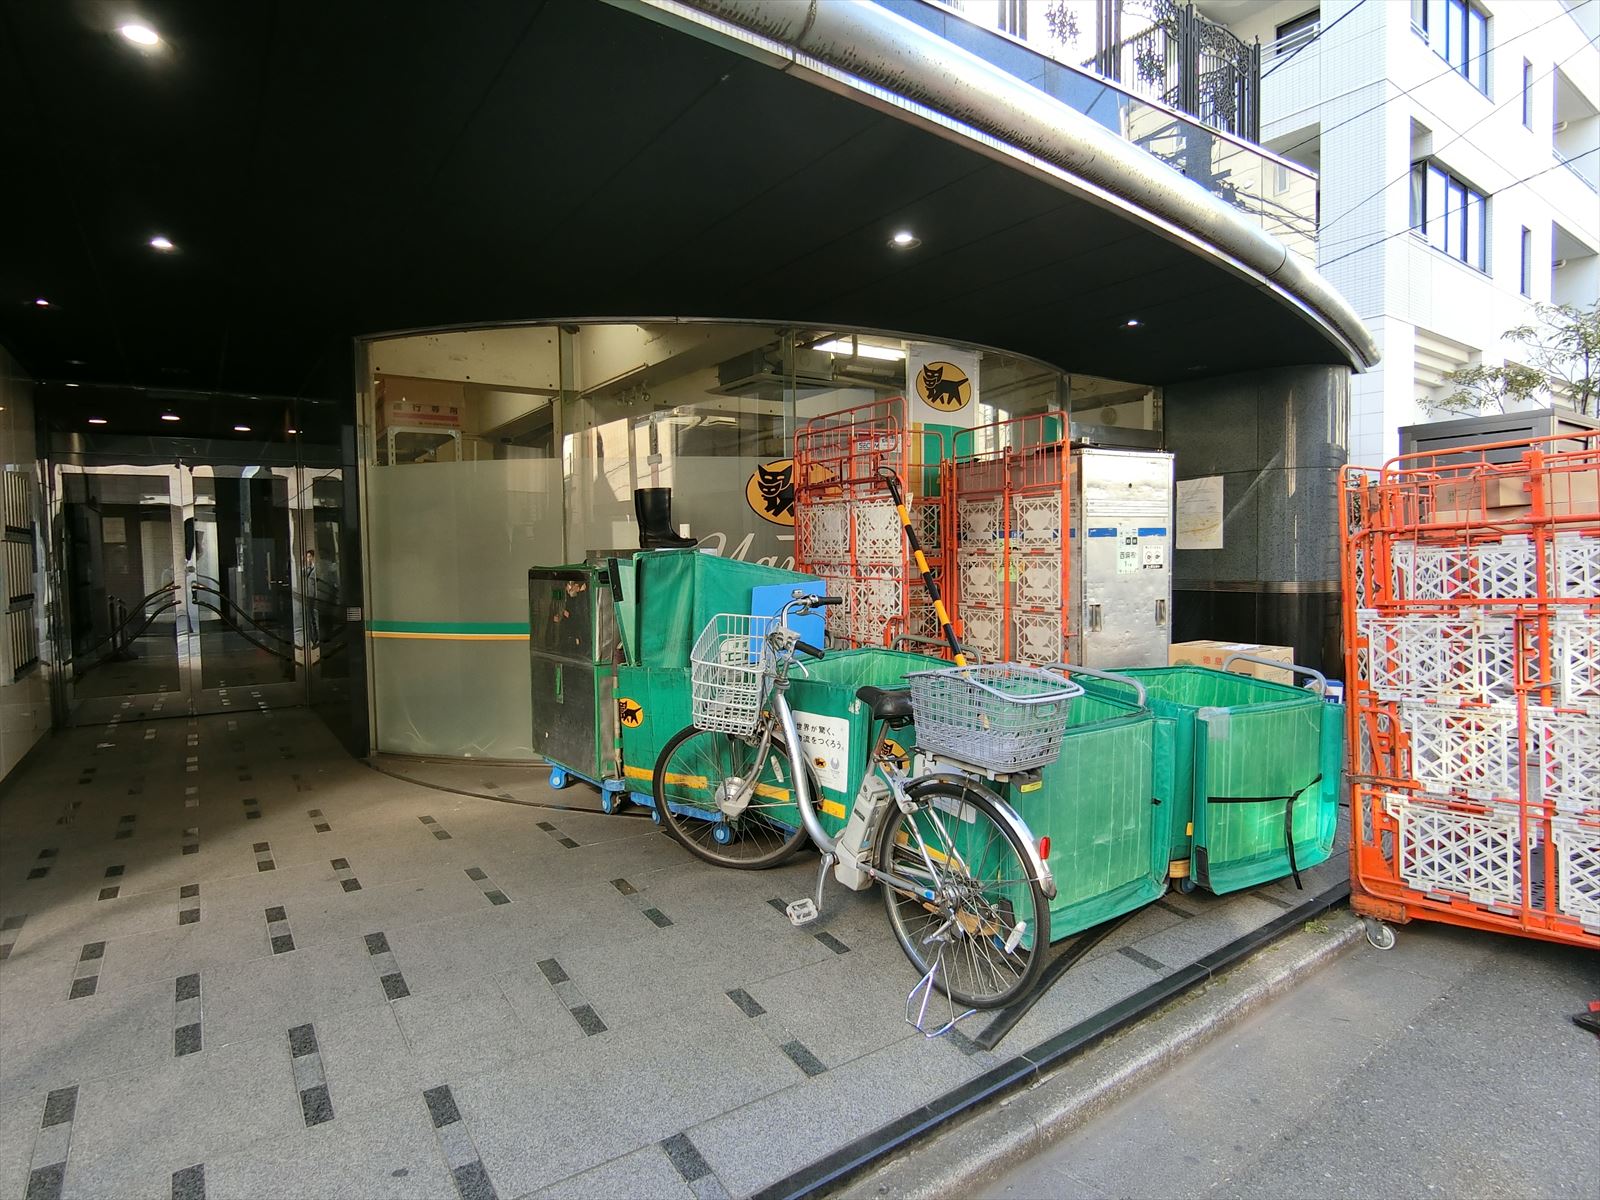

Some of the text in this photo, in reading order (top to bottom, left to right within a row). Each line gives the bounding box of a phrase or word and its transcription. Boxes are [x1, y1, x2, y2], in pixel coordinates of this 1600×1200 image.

[796, 722, 835, 736] 世界が驚く、
